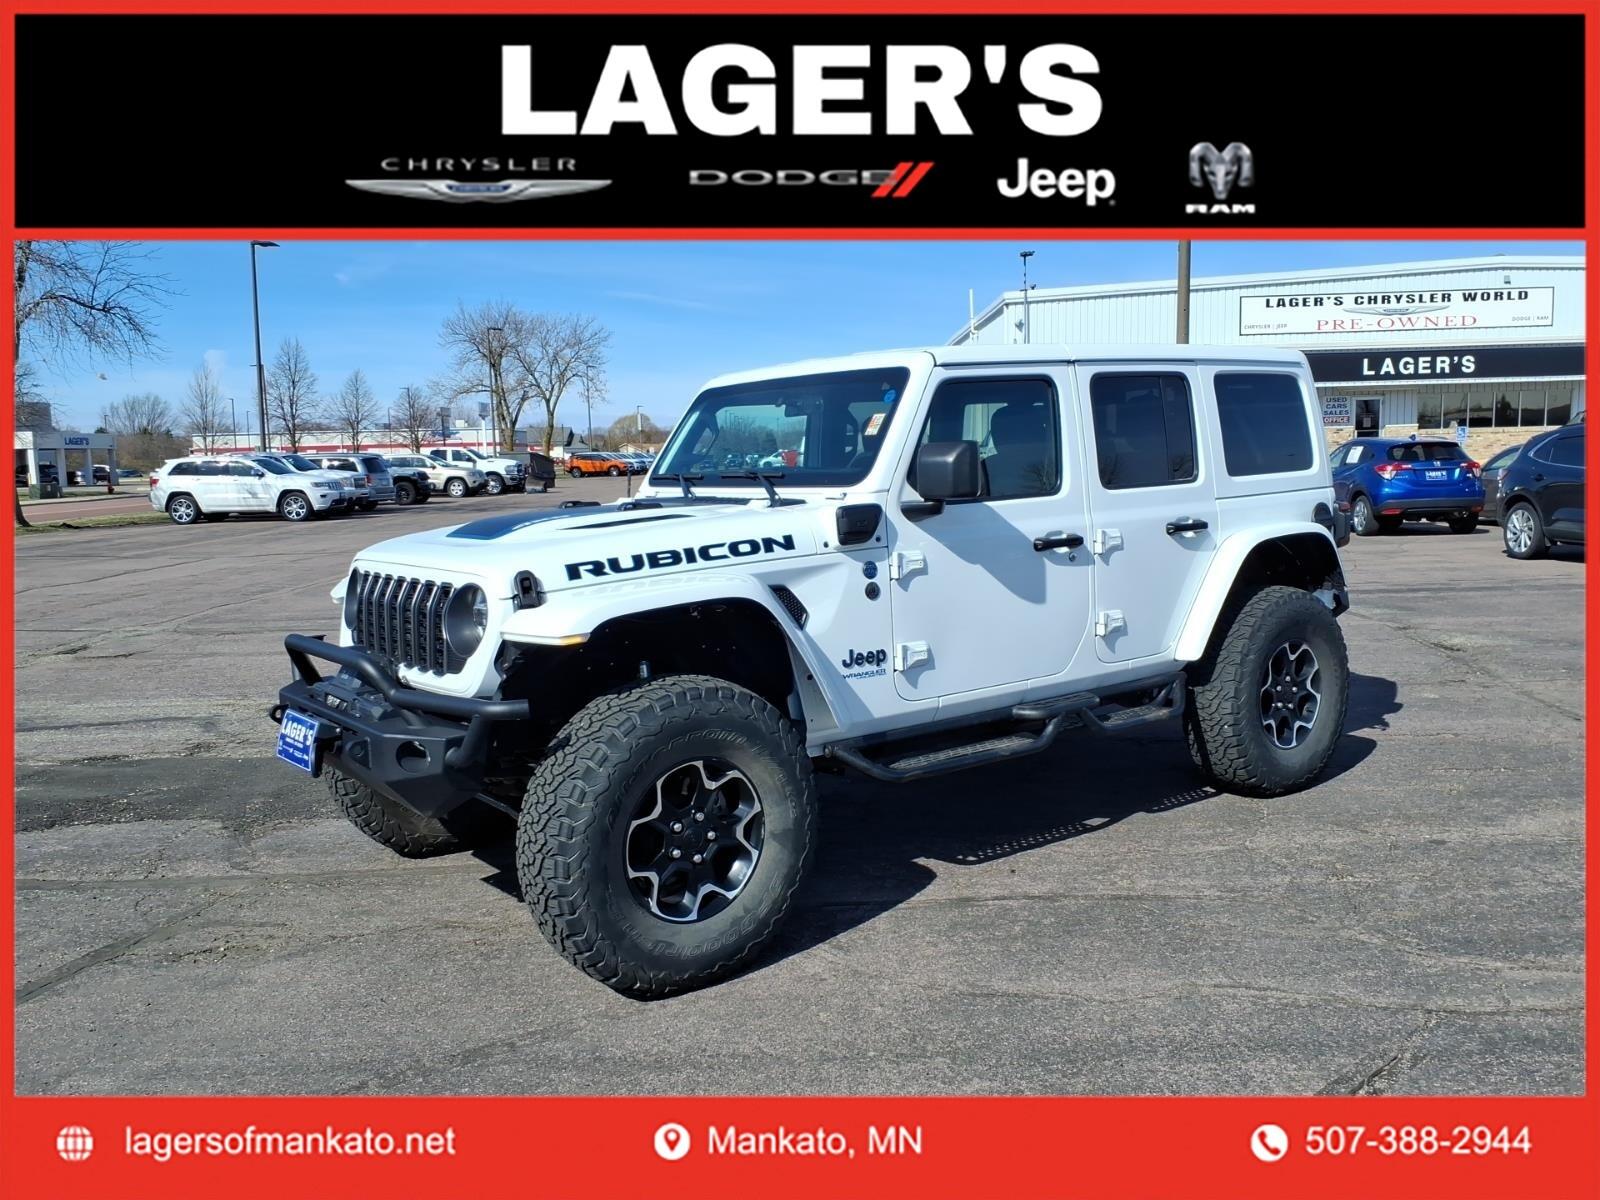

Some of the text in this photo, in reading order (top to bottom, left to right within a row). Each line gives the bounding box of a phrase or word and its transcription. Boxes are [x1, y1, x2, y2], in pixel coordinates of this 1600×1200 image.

[1265, 290, 1529, 308] LAGER'S CHRYSLER WORLD
[1316, 315, 1477, 331] PRE-OWNED
[1363, 355, 1476, 376] LAGER'S
[564, 534, 796, 581] RUBICON
[842, 648, 887, 668] Jeep
[842, 668, 887, 679] WRANGLER
[281, 719, 314, 746] LAGER'S
